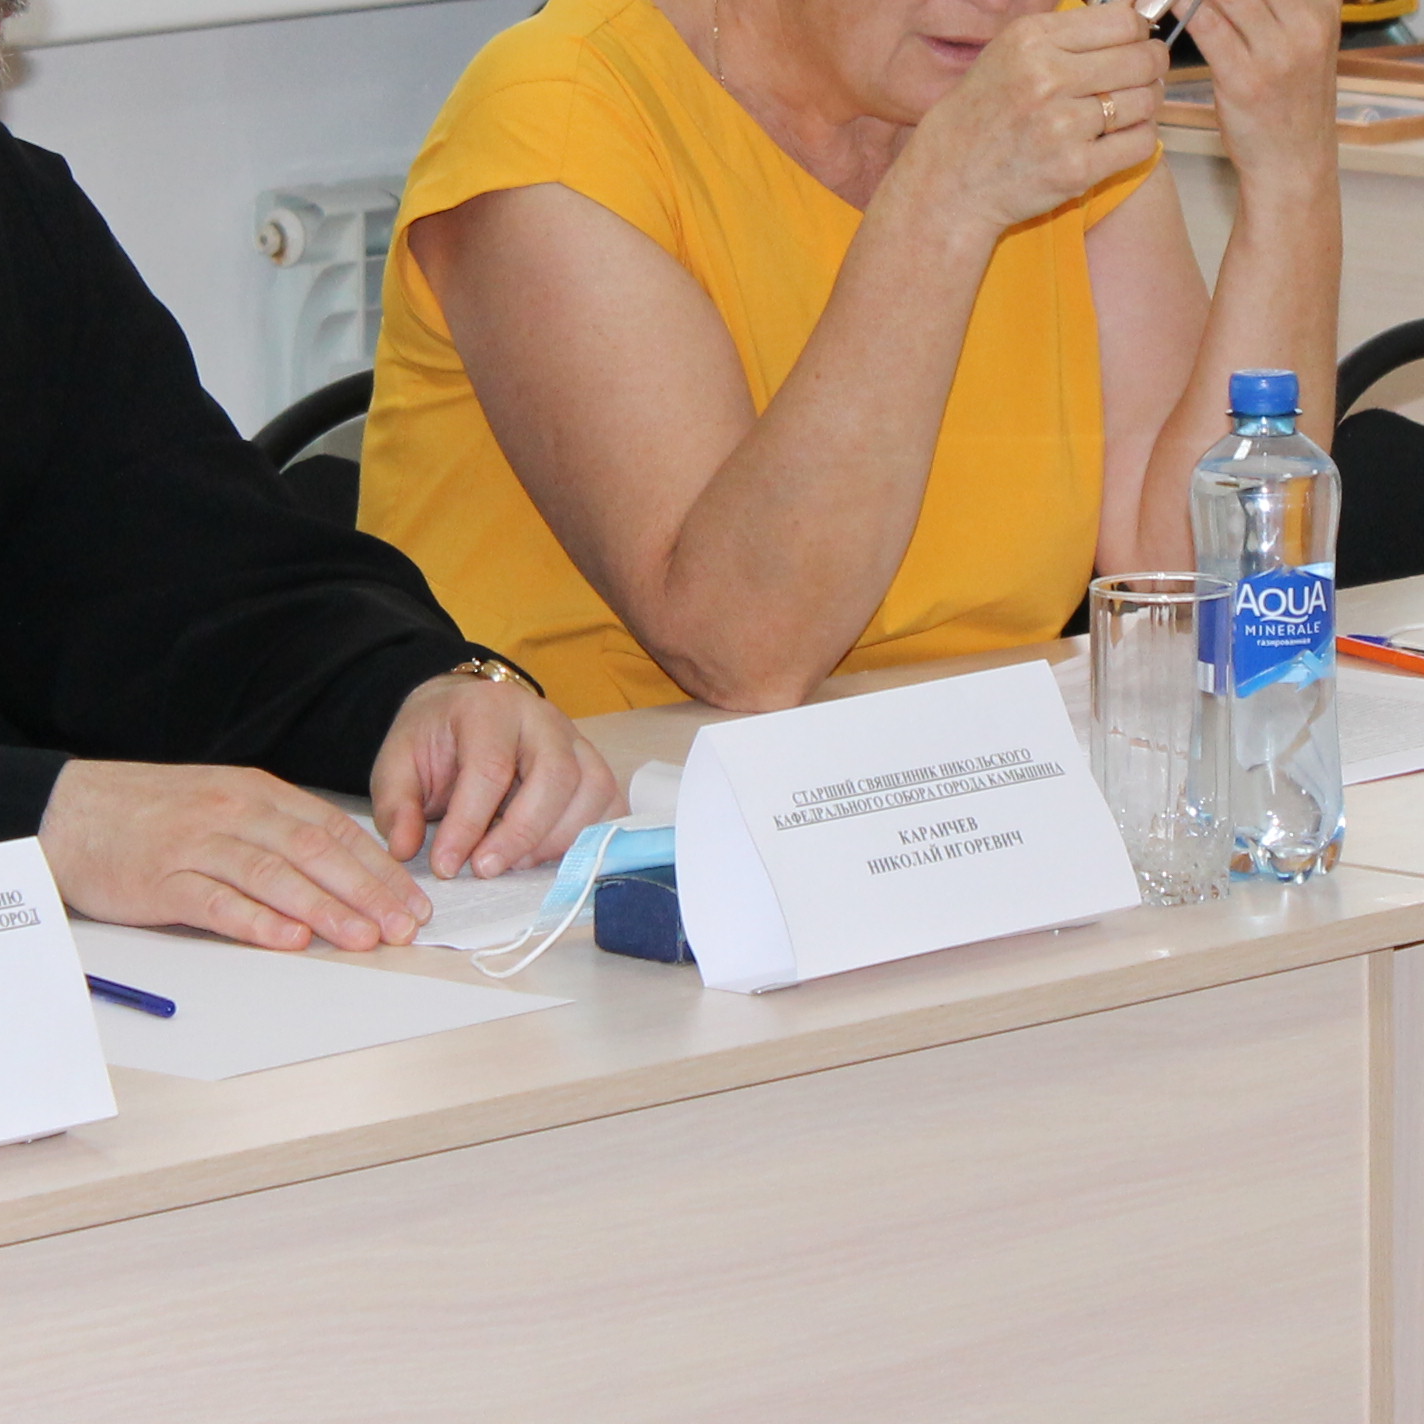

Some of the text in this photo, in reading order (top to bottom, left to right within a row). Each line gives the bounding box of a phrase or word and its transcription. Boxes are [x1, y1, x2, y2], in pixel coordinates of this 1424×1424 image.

[1236, 581, 1326, 623] AQUA
[1245, 621, 1321, 636] MINERALE
[773, 761, 1065, 829] КАФЕДРАЛЬНОГО СОБОРА ГОРОДА КАМЫШИНА
[792, 748, 1032, 806] СТАРШИЙ СВЯЩЕННИК НИКОЛЬСКОГО
[898, 816, 978, 845] КАРАИЧЕВ
[867, 830, 1024, 876] НИКОЛАЙ ИГОРЕВИЧ
